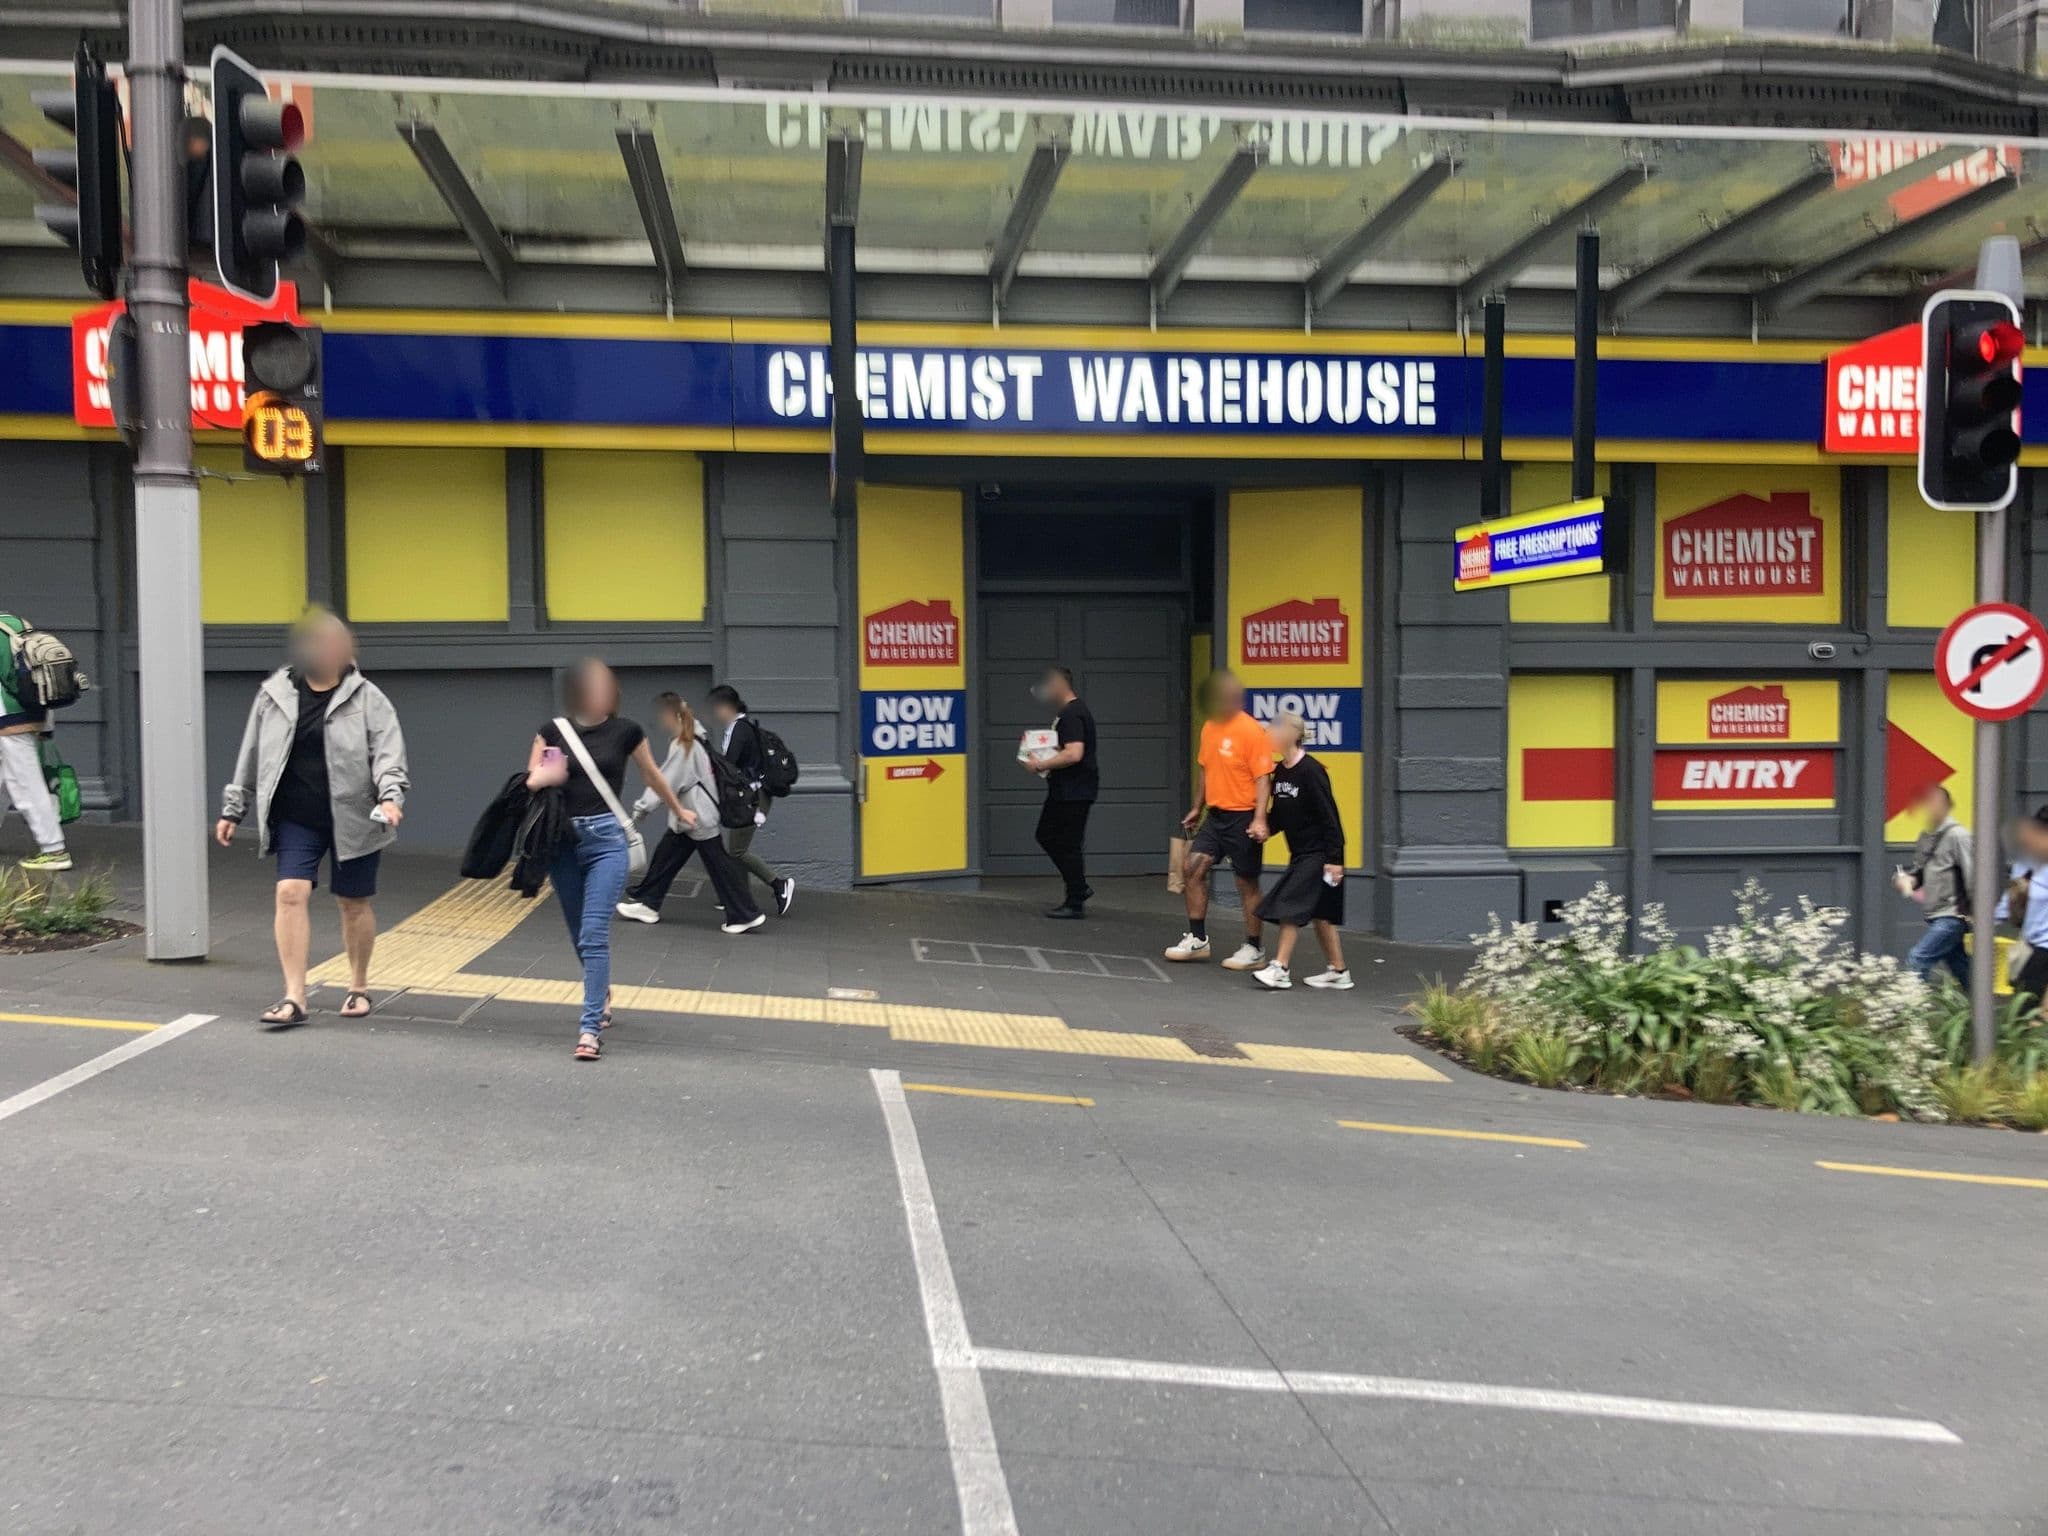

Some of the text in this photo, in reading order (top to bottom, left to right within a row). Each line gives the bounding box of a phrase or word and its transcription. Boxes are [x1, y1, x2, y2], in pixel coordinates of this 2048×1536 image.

[1068, 356, 1436, 425] WAREHOUSE
[254, 407, 314, 460] 03
[1494, 538, 1519, 562] FREE
[1671, 527, 1816, 565] CHEMIST
[1672, 565, 1812, 587] WAREHOUSE
[868, 622, 955, 646] CHEMIST
[1246, 621, 1344, 643] CHEMIST
[869, 646, 954, 660] WAREHOUSE
[1247, 645, 1342, 658] WAREHOUSE
[875, 696, 954, 723] NOW
[1252, 692, 1341, 720] NOW
[1711, 703, 1787, 723] CHEMIST
[872, 723, 956, 750] OPEN
[1711, 723, 1786, 734] WAREHOUSE
[1681, 760, 1809, 790] ENTRY
